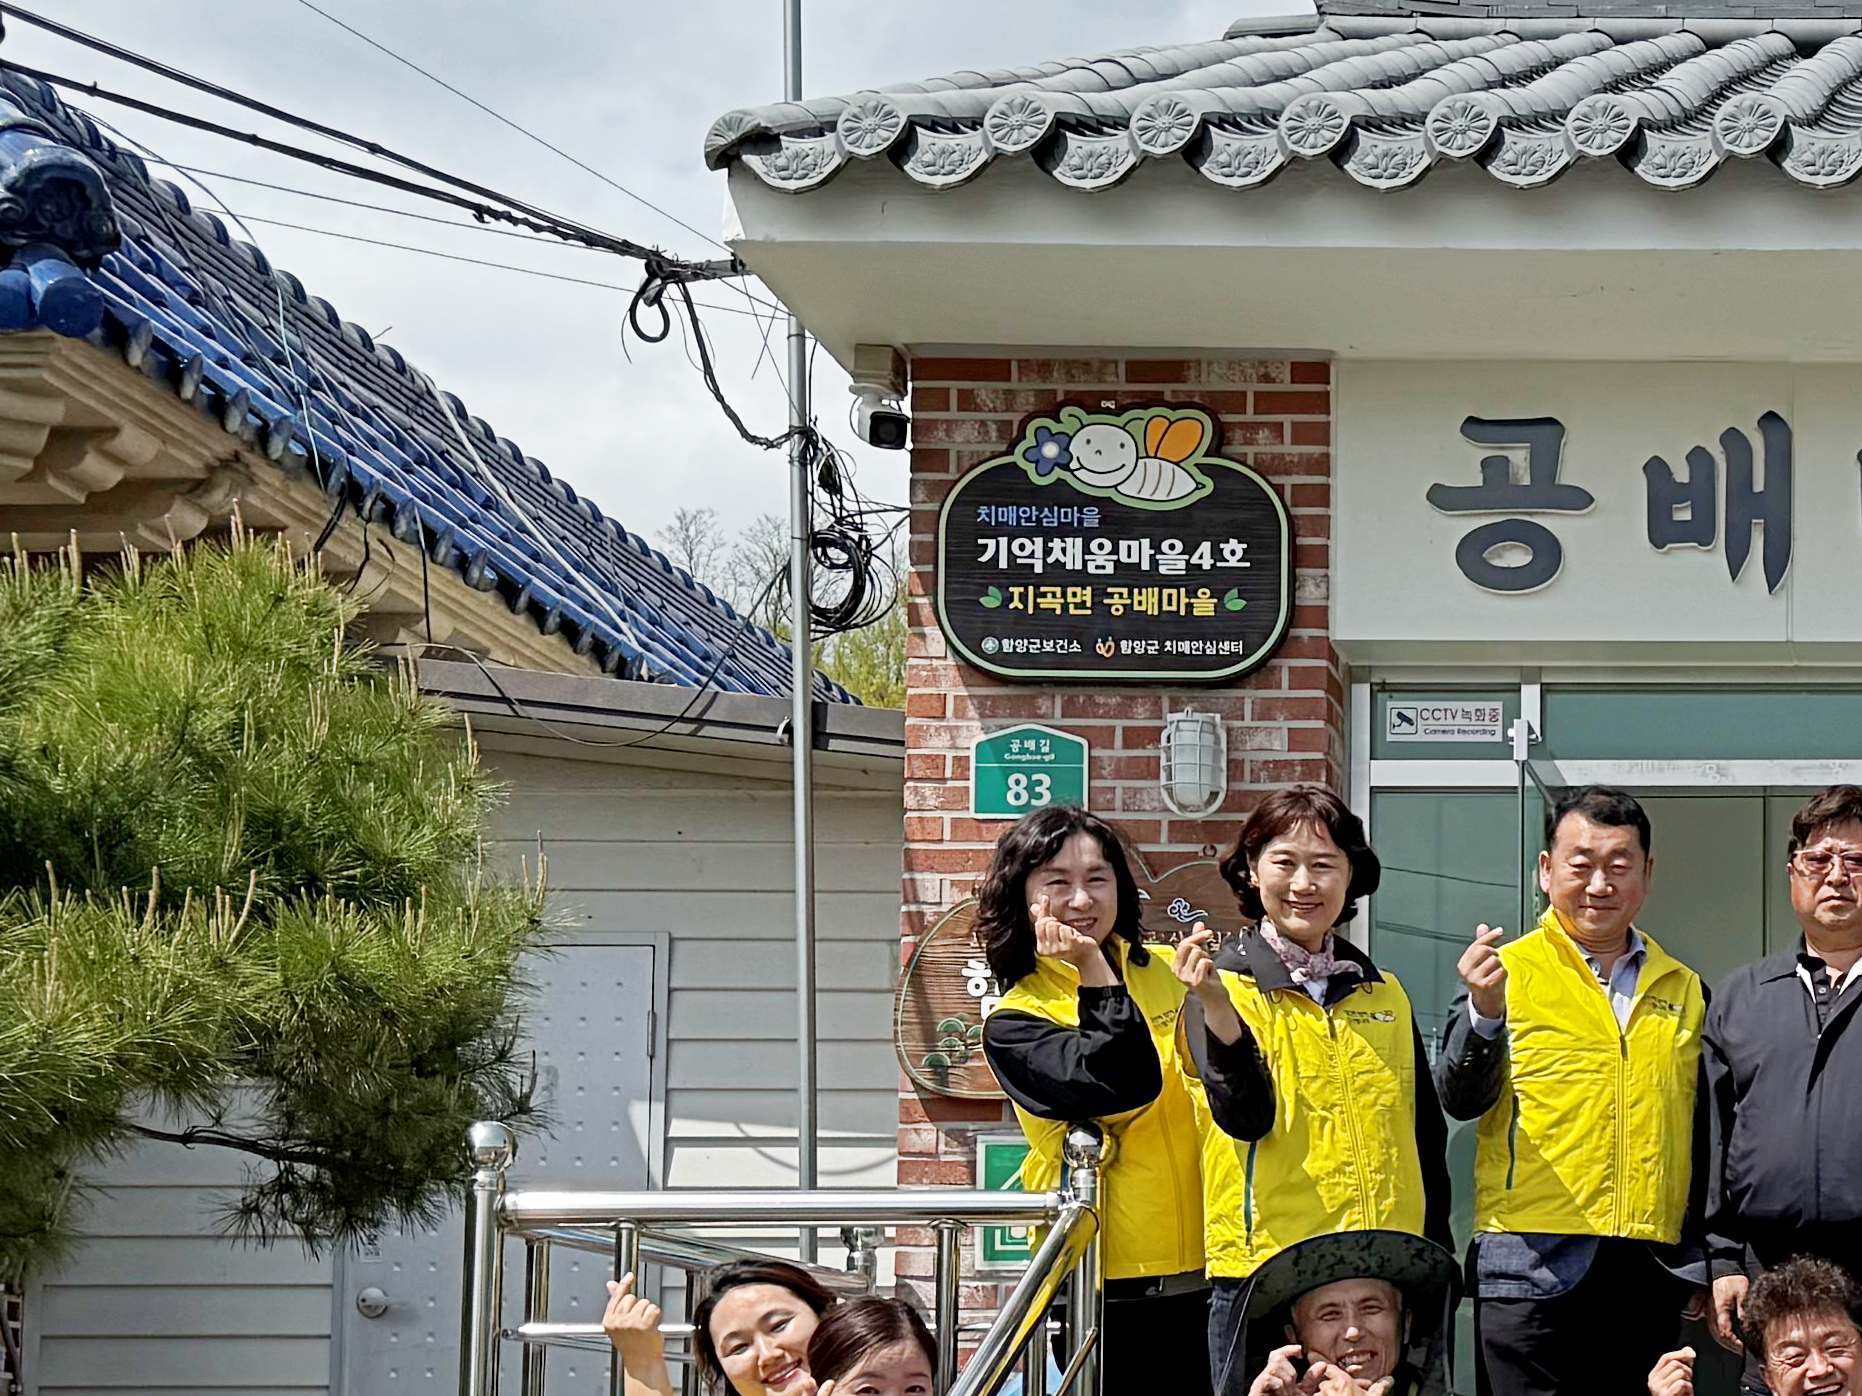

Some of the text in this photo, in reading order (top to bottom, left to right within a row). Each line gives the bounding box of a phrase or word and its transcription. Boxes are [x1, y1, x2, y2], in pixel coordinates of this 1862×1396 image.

[976, 505, 1101, 528] 치매안심마을
[977, 536, 1250, 575] 기억채움마을4호
[1008, 585, 1218, 616] 지곡면 공배마을
[1002, 638, 1082, 654] 함양군보건소
[1120, 639, 1243, 655] 함양군 치매안심센터
[1419, 708, 1458, 721] CCTV
[1457, 728, 1496, 737] Recording
[1006, 773, 1052, 806] 83
